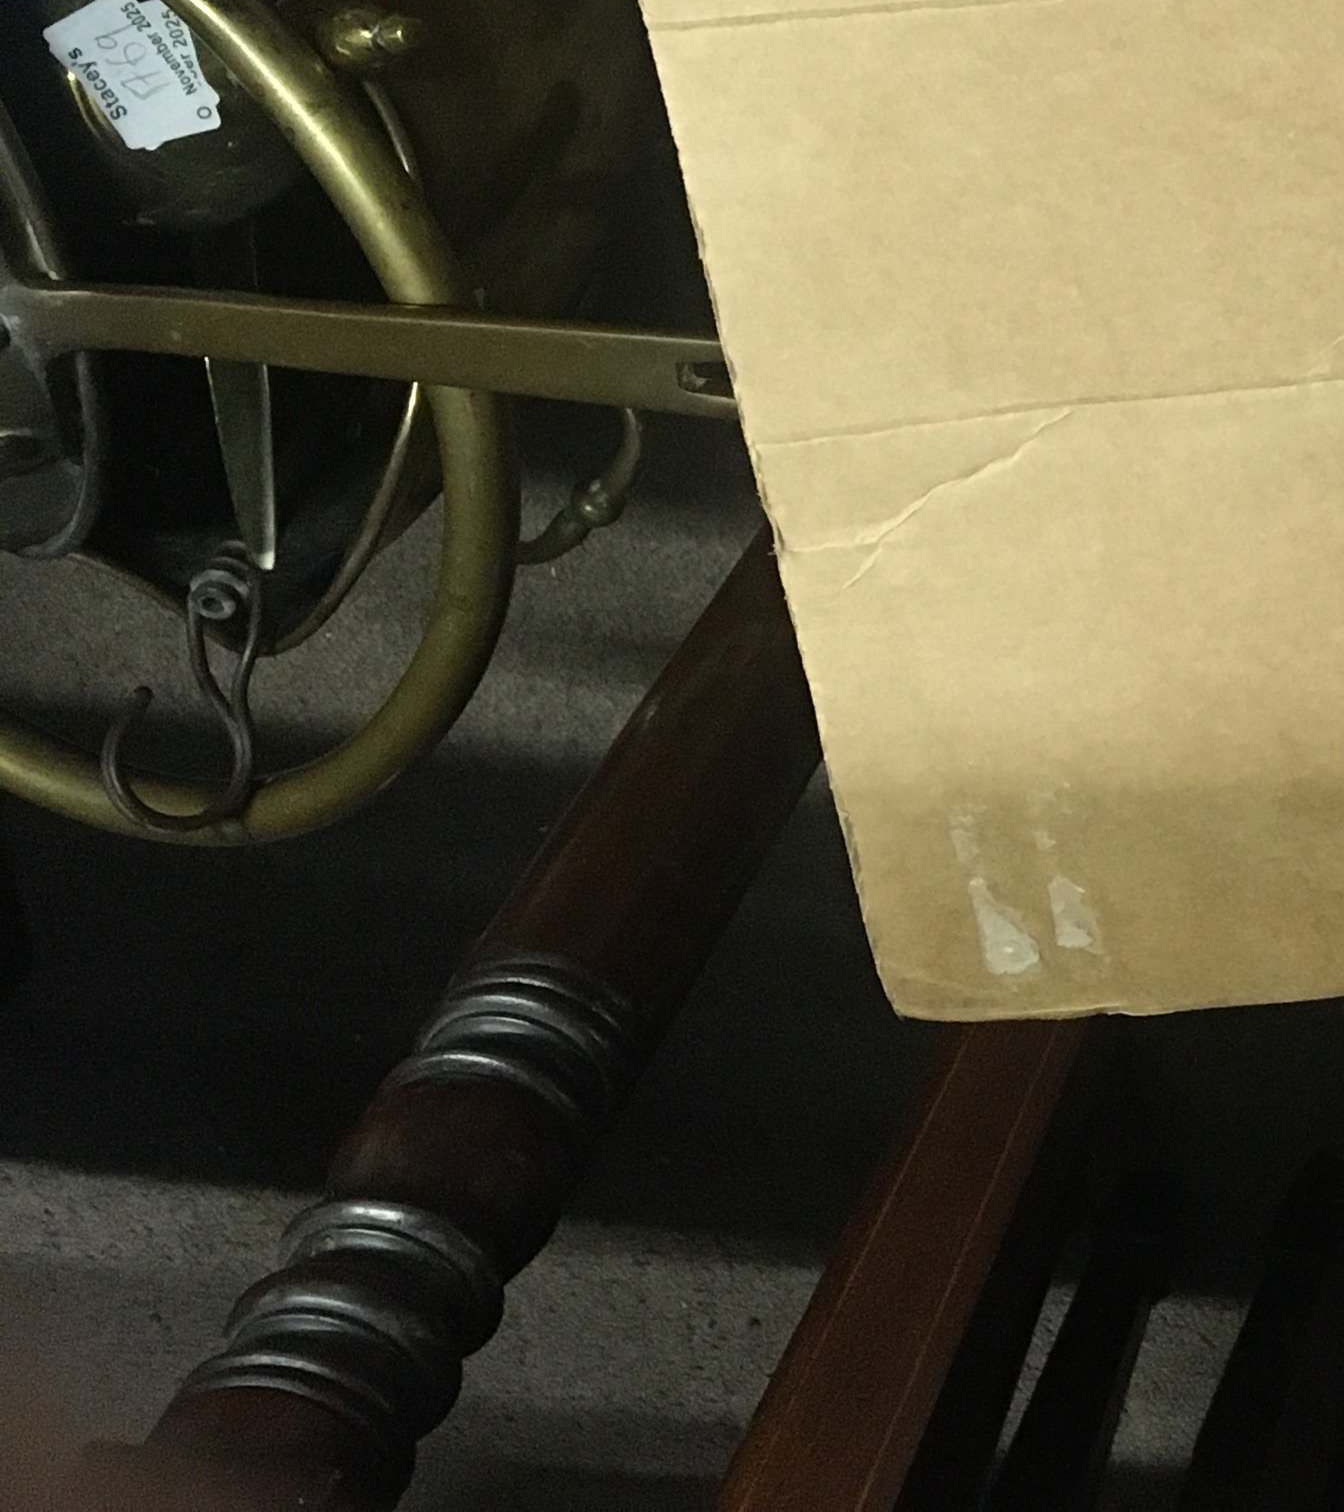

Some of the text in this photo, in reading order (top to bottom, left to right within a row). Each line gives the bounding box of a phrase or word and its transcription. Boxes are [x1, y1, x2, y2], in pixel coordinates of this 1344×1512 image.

[120, 1, 152, 33] 2025
[67, 47, 128, 121] Stacey's
[147, 31, 198, 96] November
